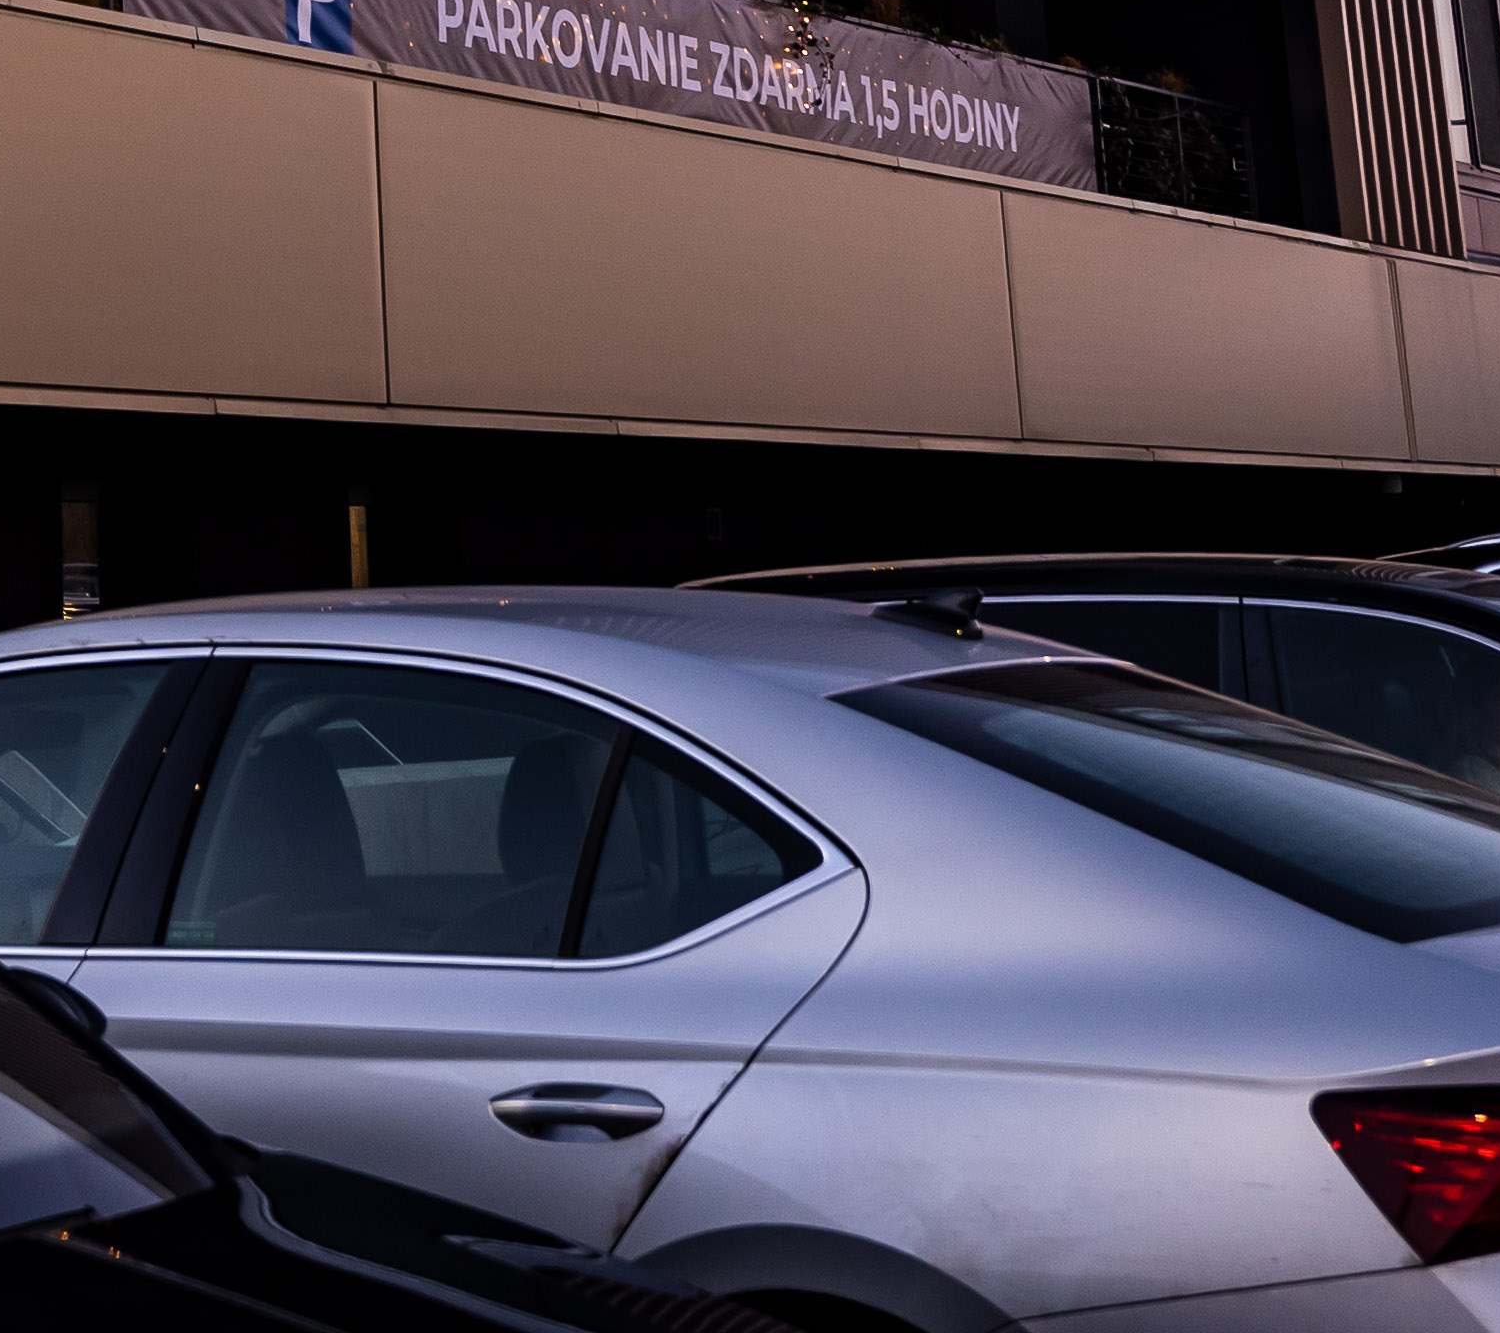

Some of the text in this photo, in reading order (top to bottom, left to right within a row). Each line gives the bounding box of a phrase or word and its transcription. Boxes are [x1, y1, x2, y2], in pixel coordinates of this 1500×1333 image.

[709, 41, 857, 124] ZDARMA
[860, 74, 901, 139] 1,5
[908, 83, 1020, 153] HODINY
